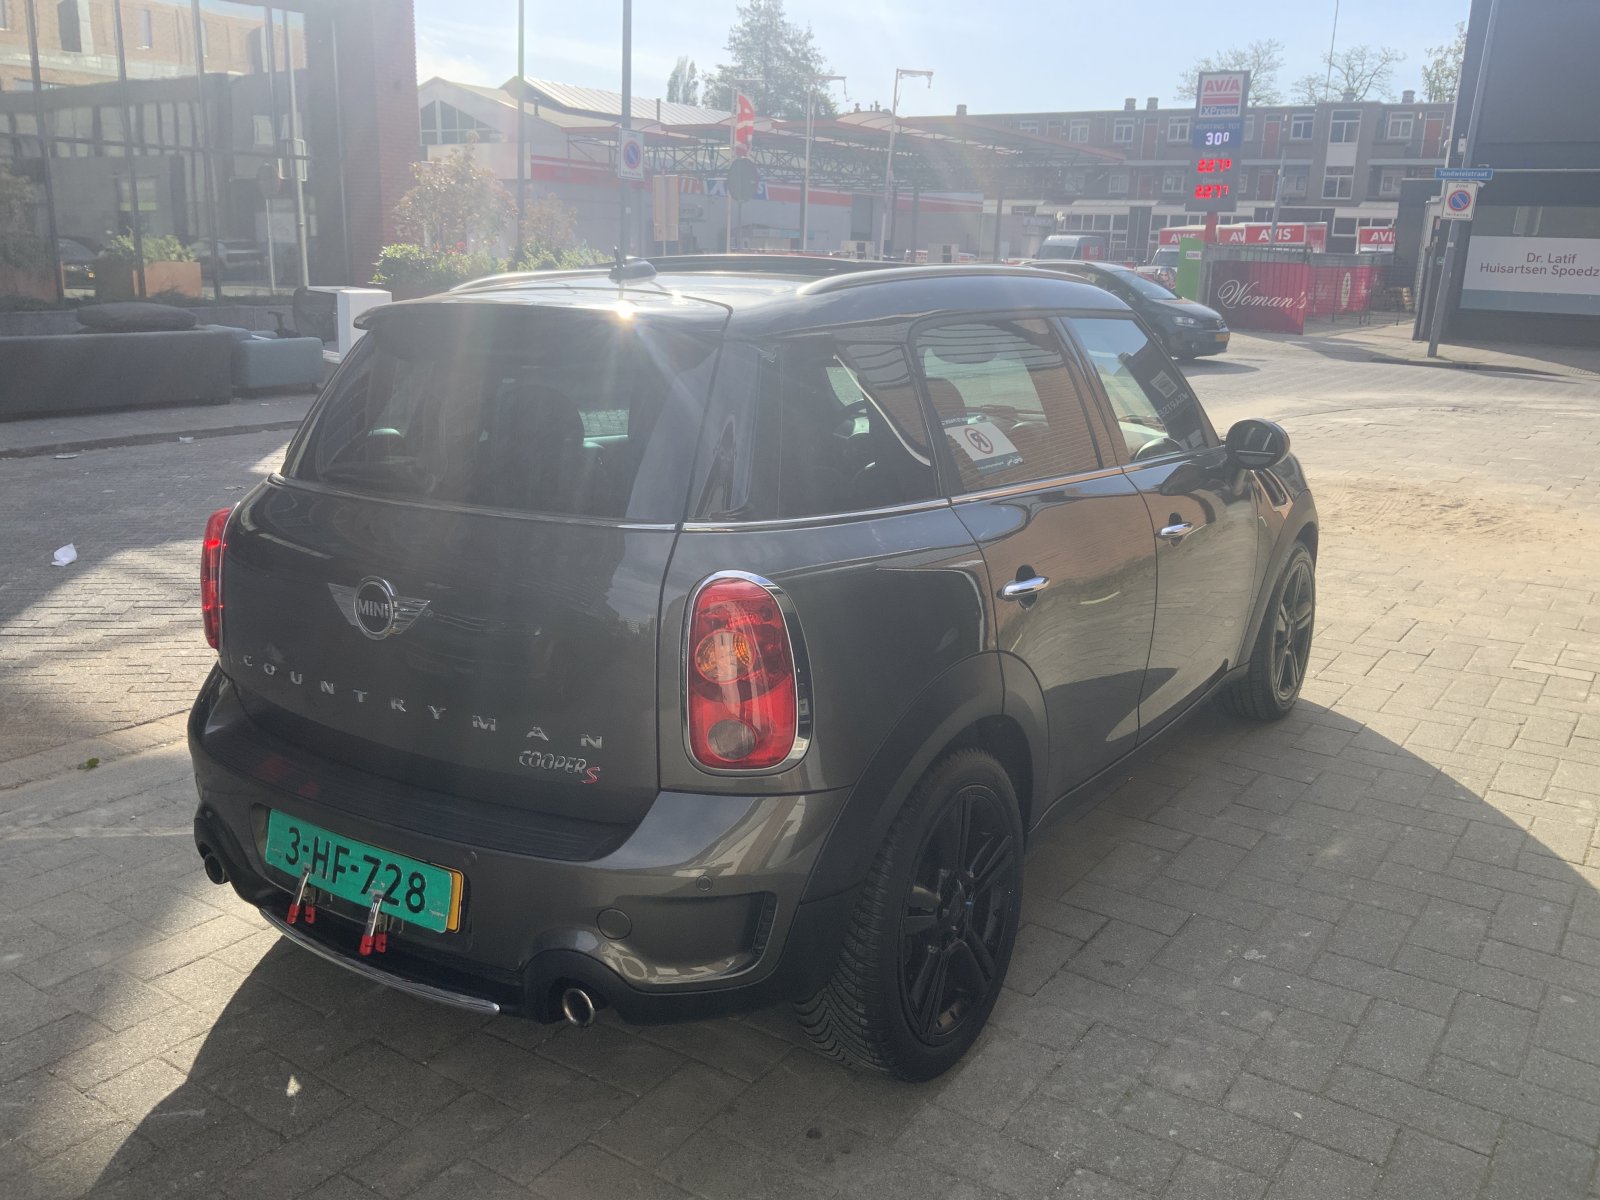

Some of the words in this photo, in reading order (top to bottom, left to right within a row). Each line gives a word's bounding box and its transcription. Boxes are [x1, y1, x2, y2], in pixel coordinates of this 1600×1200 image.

[1205, 76, 1240, 93] AVIA
[1203, 106, 1237, 116] XPress
[1439, 169, 1489, 178] Tandwielstraat
[1526, 252, 1544, 263] Dr.
[1548, 252, 1578, 264] Latif
[1480, 262, 1547, 275] Huisartsen
[1217, 279, 1307, 309] Woman's
[358, 597, 390, 620] MINI
[242, 654, 603, 749] COUNTRYMAN
[518, 750, 586, 775] COOPER
[285, 826, 427, 914] 3-HF-728
